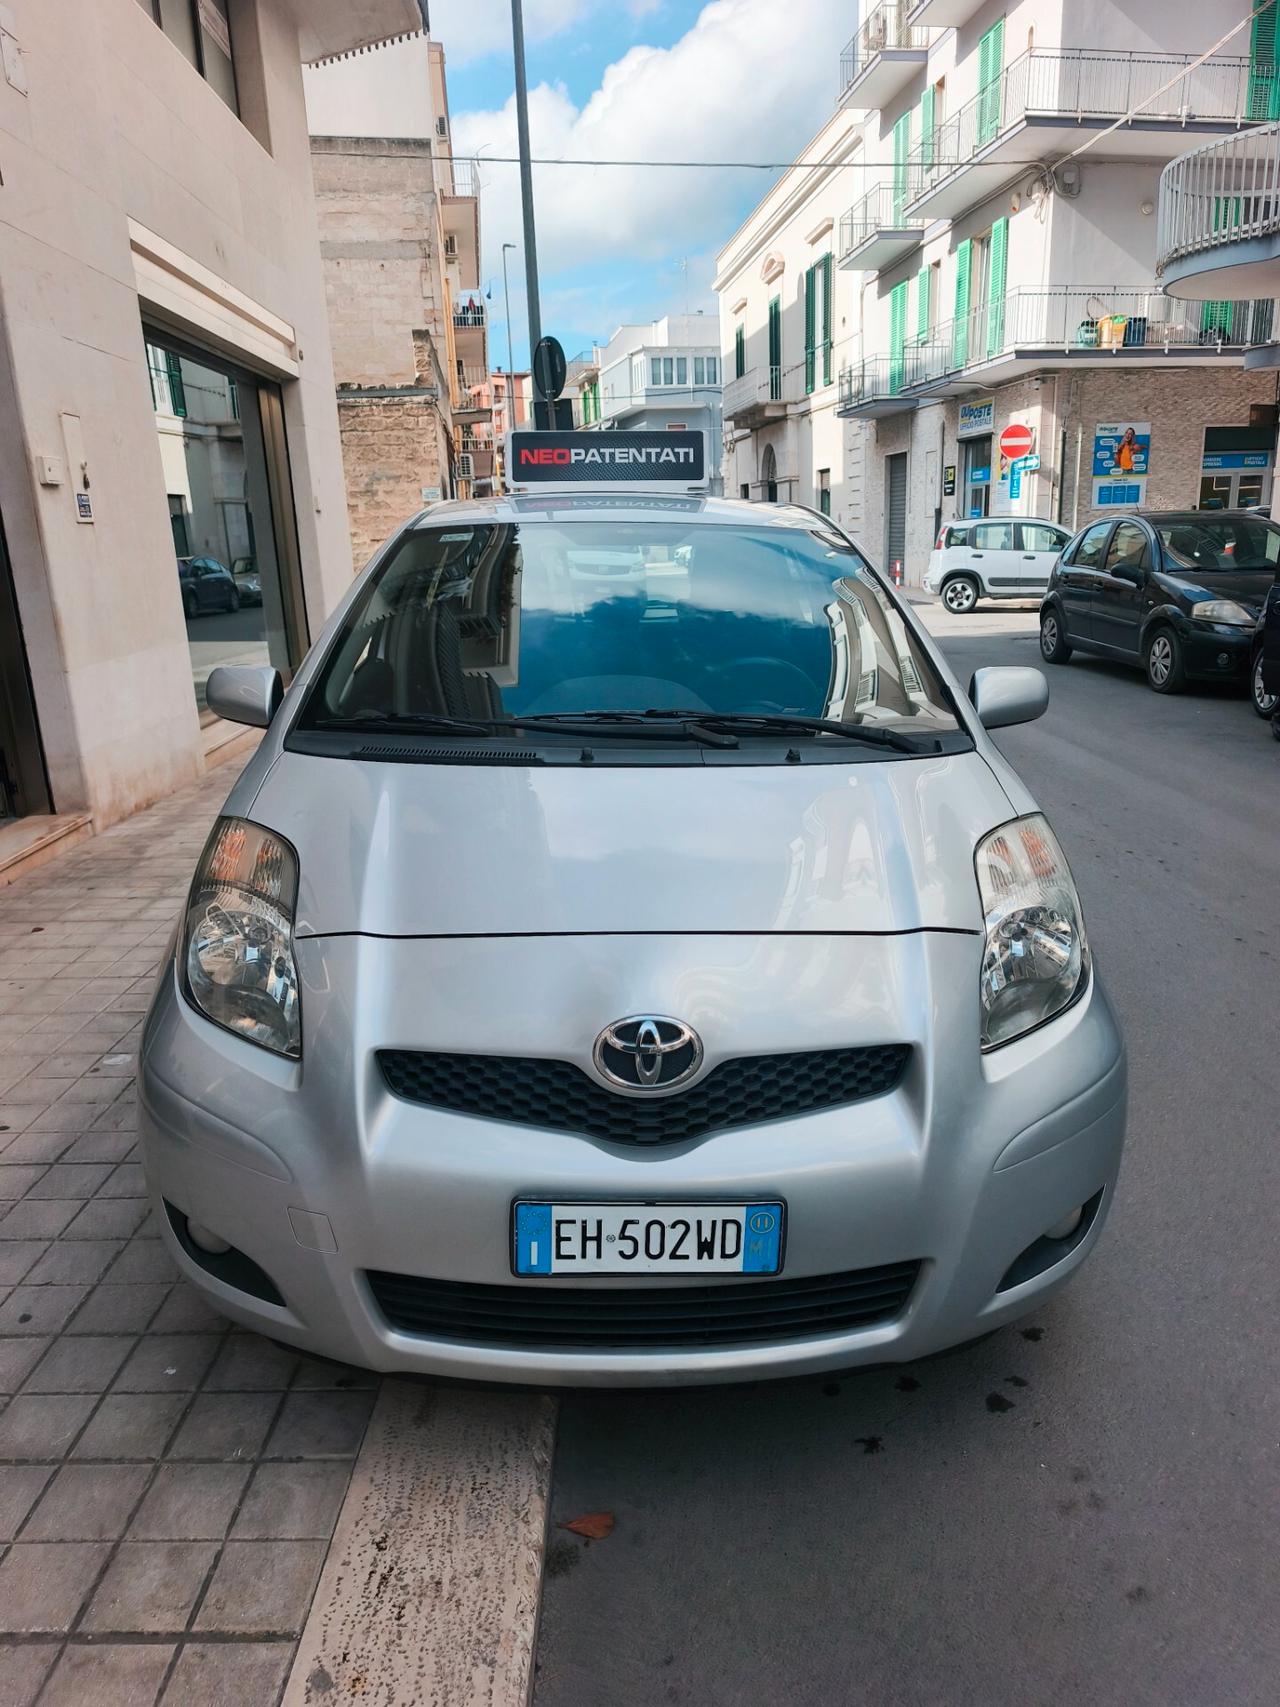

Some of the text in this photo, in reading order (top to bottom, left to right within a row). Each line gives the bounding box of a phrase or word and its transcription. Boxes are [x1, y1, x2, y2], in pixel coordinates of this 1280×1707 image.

[520, 448, 694, 465] NEOPATENTATI
[555, 1218, 742, 1260] EH 502WD
[530, 1241, 538, 1266] I
